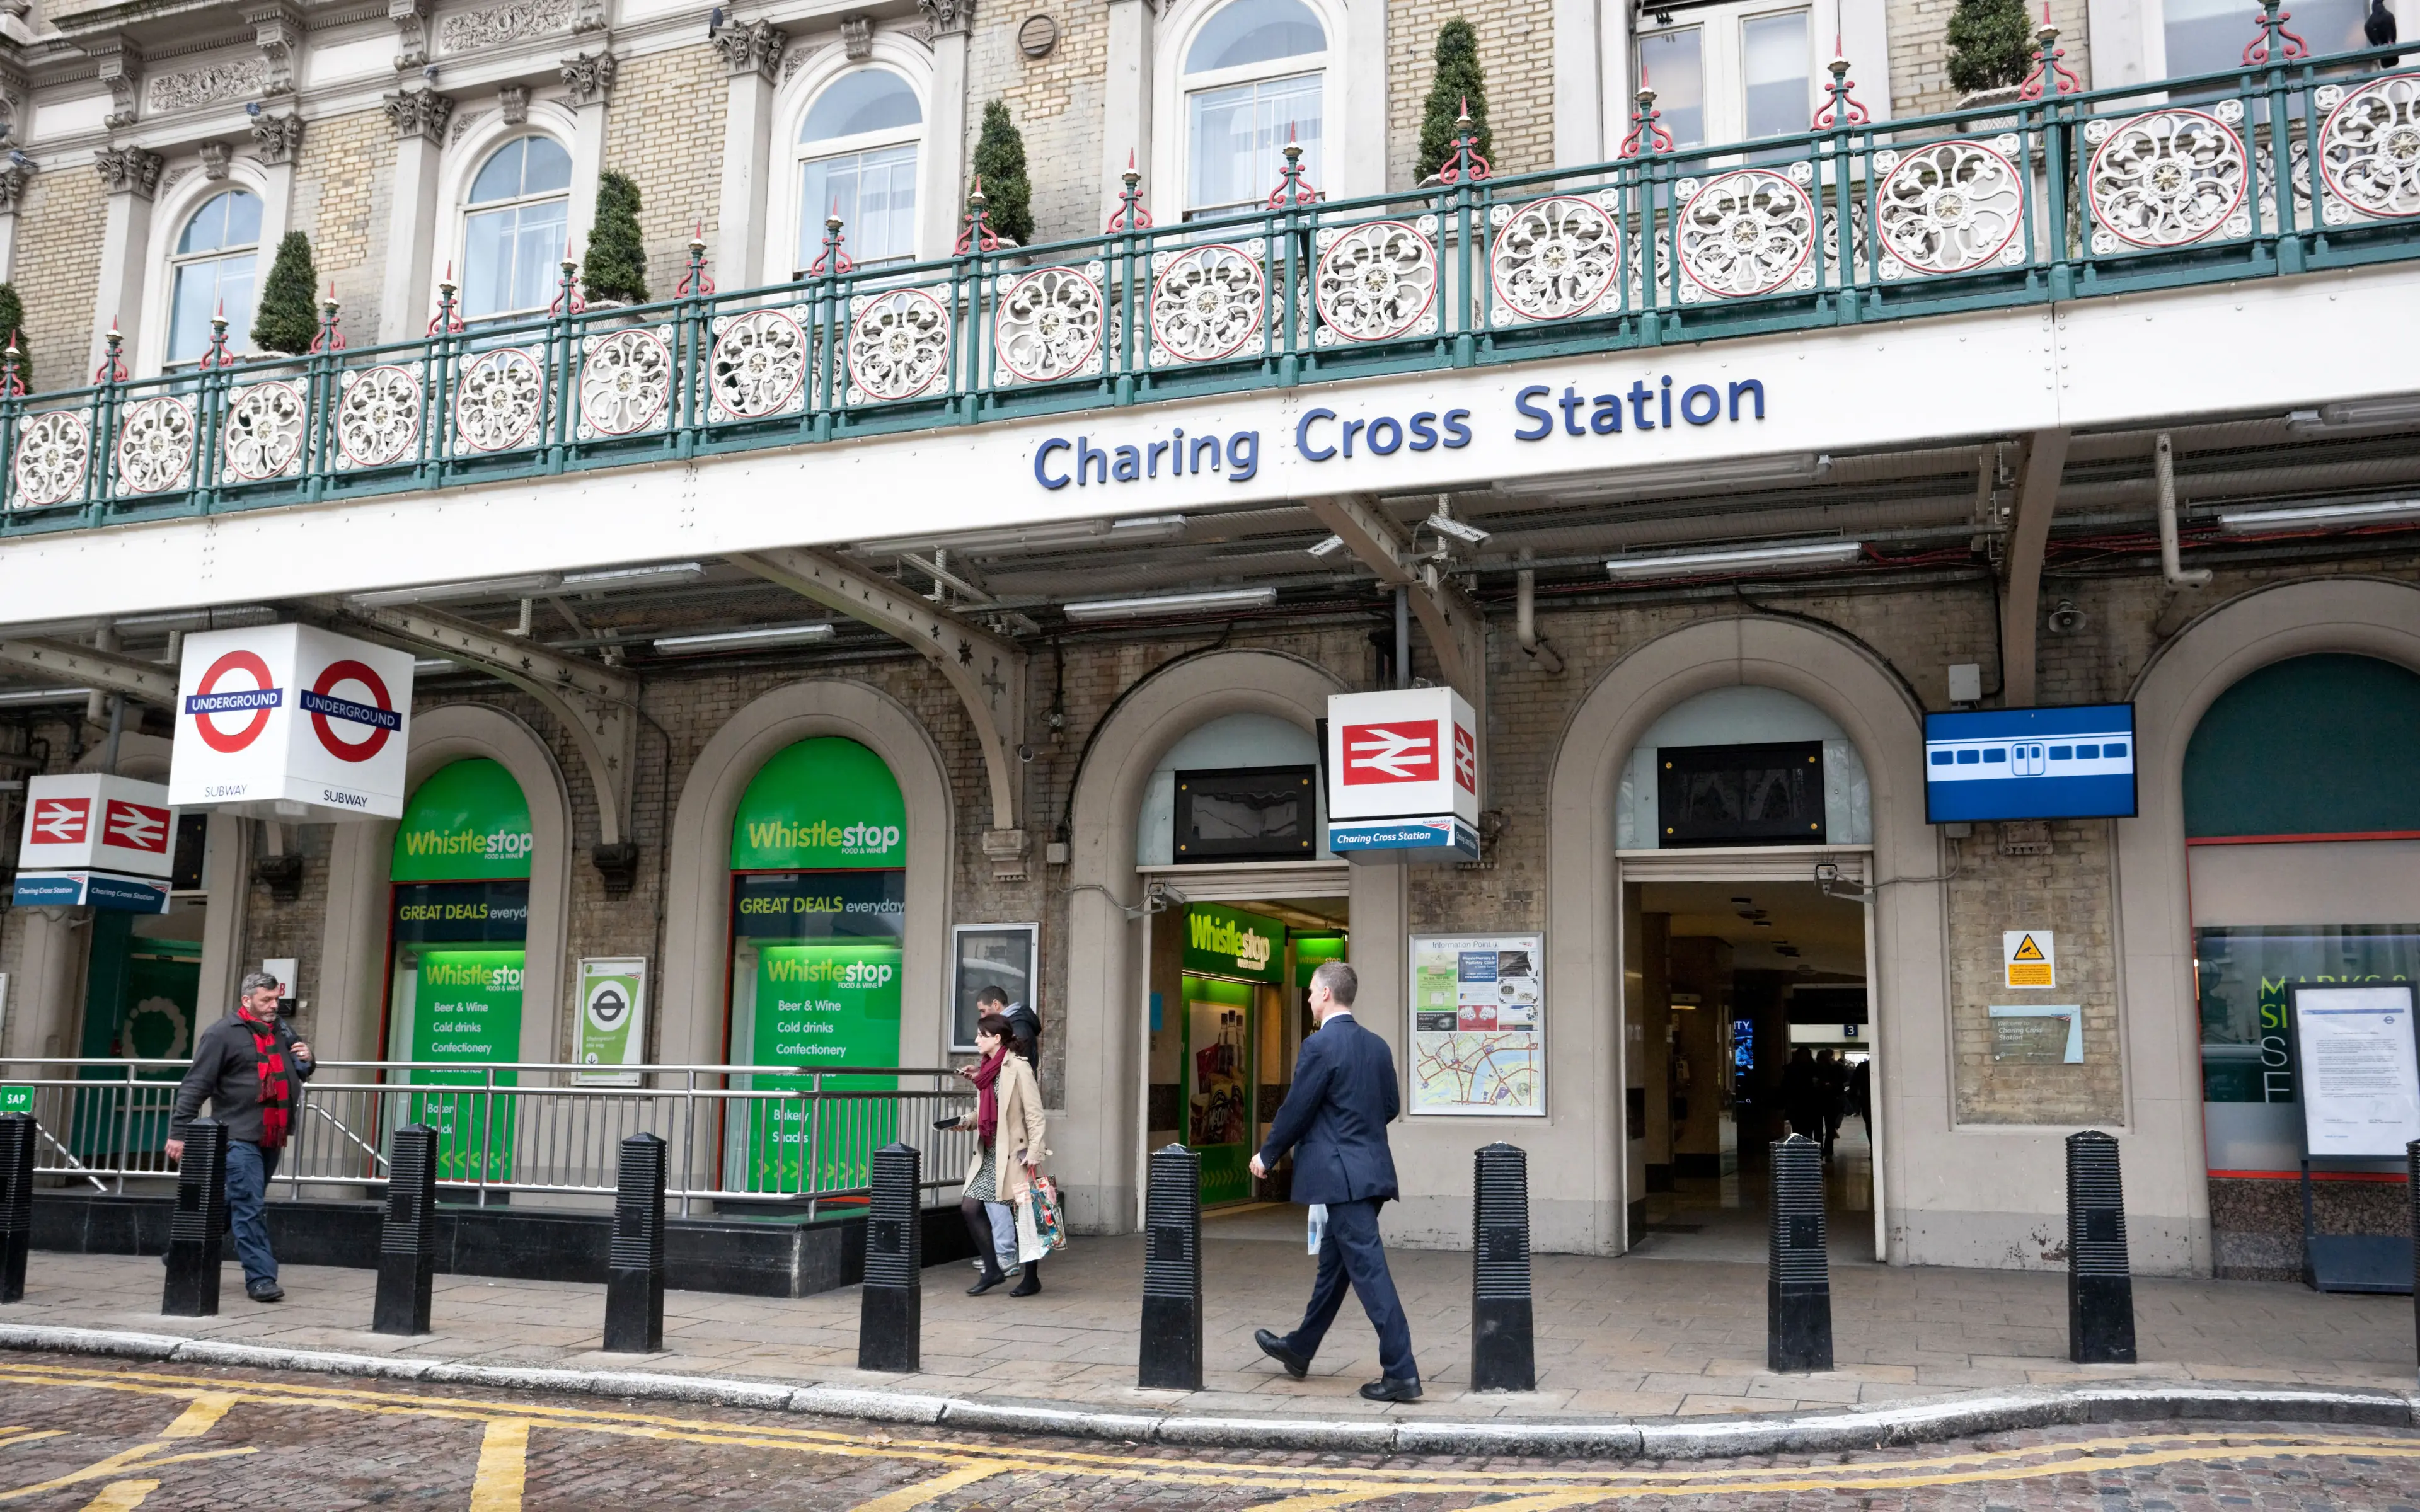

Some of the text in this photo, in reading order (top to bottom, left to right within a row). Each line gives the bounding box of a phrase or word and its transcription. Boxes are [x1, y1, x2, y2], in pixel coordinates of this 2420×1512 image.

[1035, 374, 1766, 490] Charing Cross Station
[1465, 530, 1482, 539] PHILIPS
[1313, 542, 1330, 553] PHILIPS
[192, 692, 277, 711] UNDERGROUND
[306, 694, 396, 727] UNDERGROUND
[205, 784, 248, 798] SUBWAY
[323, 789, 368, 808] SUBWAY
[406, 828, 533, 858] Whistlestop
[749, 820, 899, 853] Whistlestop
[1337, 832, 1431, 844] Charing Cross Station
[91, 887, 155, 901] Charing Cross Station
[400, 903, 528, 921] GREAT DEALS everyd
[740, 897, 904, 915] GREAT DEALS everyday
[1190, 914, 1270, 970] Whistlestop
[768, 959, 892, 987] Whistlestop
[434, 1002, 488, 1012] Beer & Wine
[778, 1000, 841, 1011] Beer & Wine
[433, 1022, 481, 1033] Cold drinks
[777, 1022, 834, 1033] Cold drinks
[1848, 1026, 1854, 1034] 3
[432, 1043, 492, 1055] Confectionery
[776, 1043, 846, 1058] Confectionery
[6, 1094, 26, 1104] SAP
